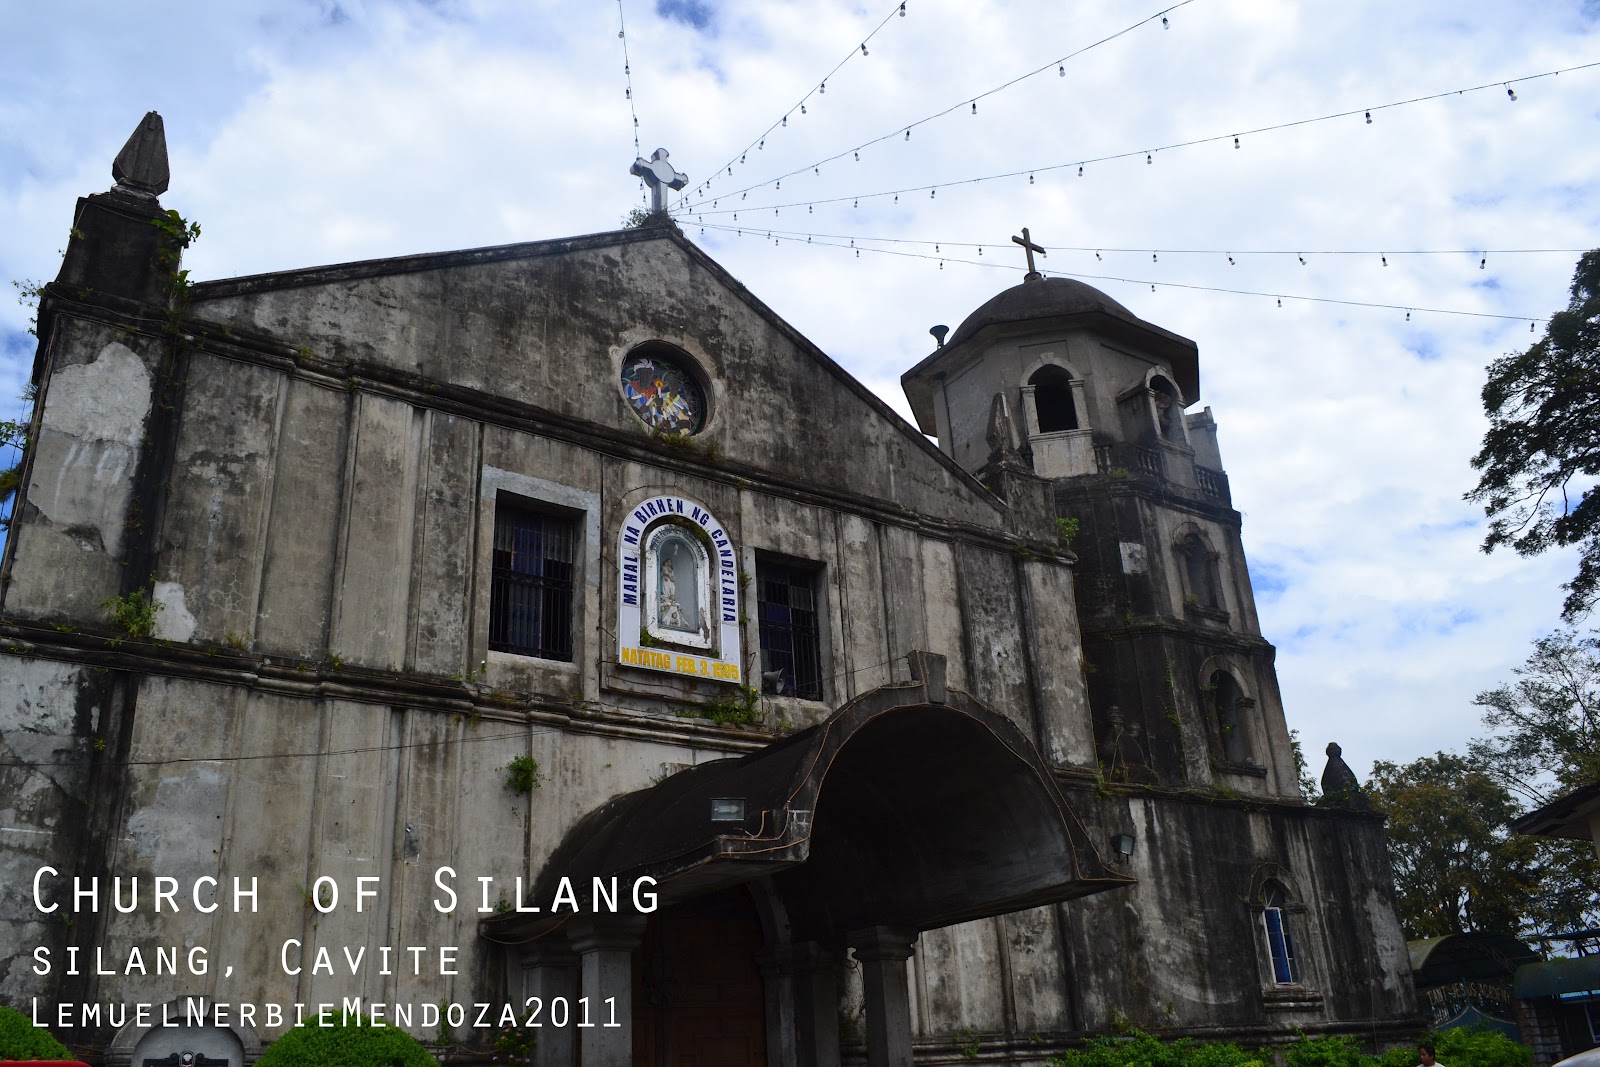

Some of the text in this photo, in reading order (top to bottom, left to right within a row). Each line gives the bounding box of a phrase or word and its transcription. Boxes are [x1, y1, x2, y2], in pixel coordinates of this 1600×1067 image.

[634, 498, 684, 524] BIRHEN
[691, 508, 710, 526] NG
[624, 525, 641, 546] NA
[623, 556, 638, 606] MAHAL
[711, 528, 737, 622] CANDELARIA
[622, 647, 671, 669] NATATAG
[676, 657, 698, 674] FEB.
[711, 662, 739, 680] 1595
